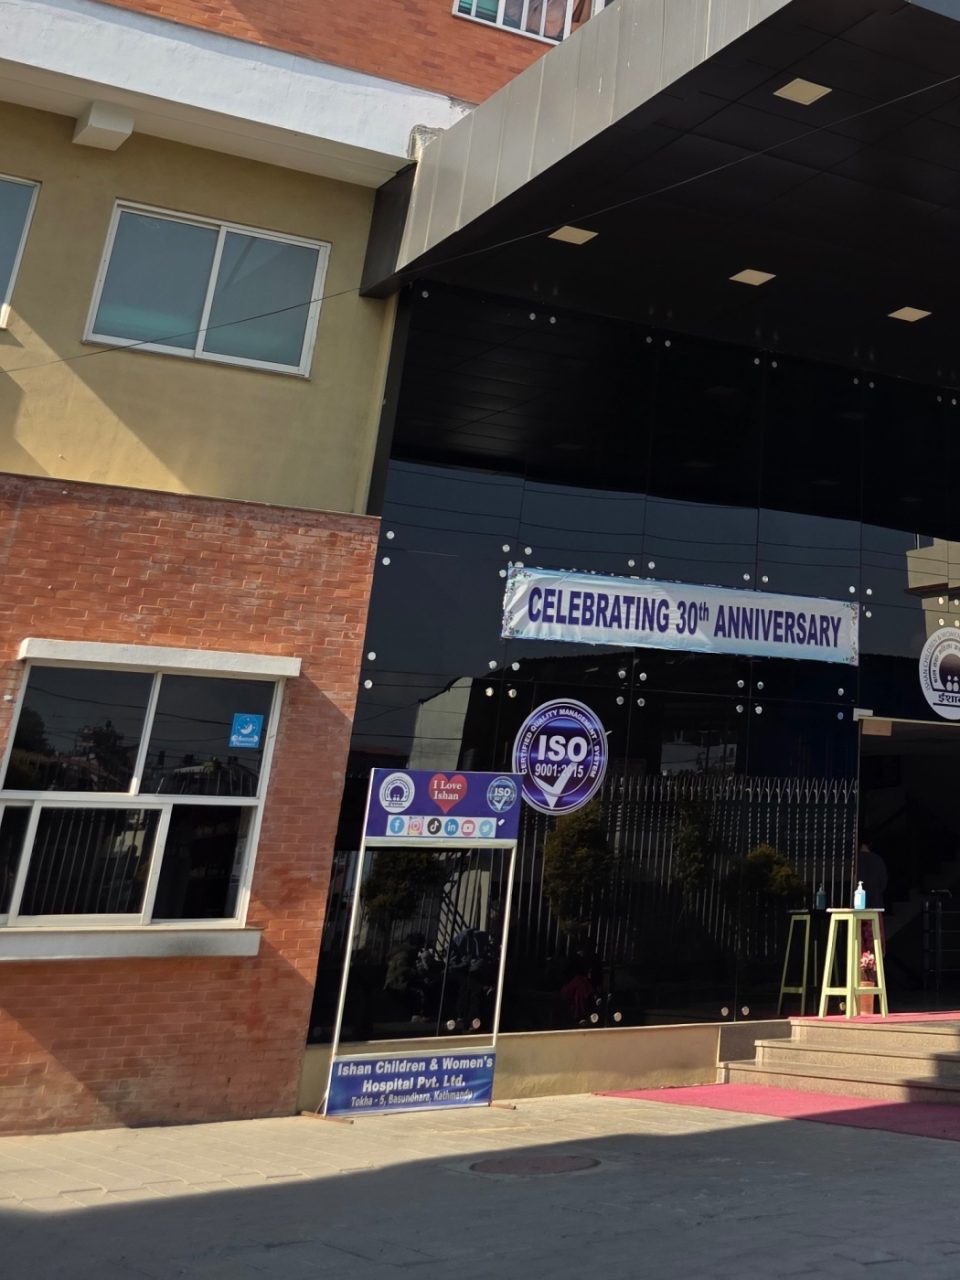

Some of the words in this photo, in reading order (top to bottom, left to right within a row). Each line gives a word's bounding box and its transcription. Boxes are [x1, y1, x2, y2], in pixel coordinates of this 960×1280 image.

[528, 586, 671, 634] CELEBRATING
[676, 600, 710, 635] 30th
[714, 604, 842, 648] ANNIVERSARY
[520, 731, 533, 775] CERTIFIED
[530, 708, 559, 732] QUALITY
[559, 708, 598, 740] MANAGEMENT
[589, 745, 601, 778] SYSTEM
[537, 734, 588, 763] ISO
[535, 763, 584, 778] 9001:215
[433, 780, 438, 790] I
[440, 780, 463, 790] Love
[494, 787, 512, 797] ISO
[433, 790, 459, 801] Ishan
[337, 1063, 371, 1076] Ishan
[375, 1058, 426, 1074] Children
[429, 1058, 439, 1070] &
[442, 1056, 493, 1070] Women's
[362, 1076, 414, 1093] Hospital
[416, 1076, 440, 1089] Pvt.
[443, 1074, 466, 1088] Ltd.
[351, 1096, 373, 1107] Tokha
[379, 1095, 387, 1106] 5,
[433, 1089, 473, 1101] Kathmandu
